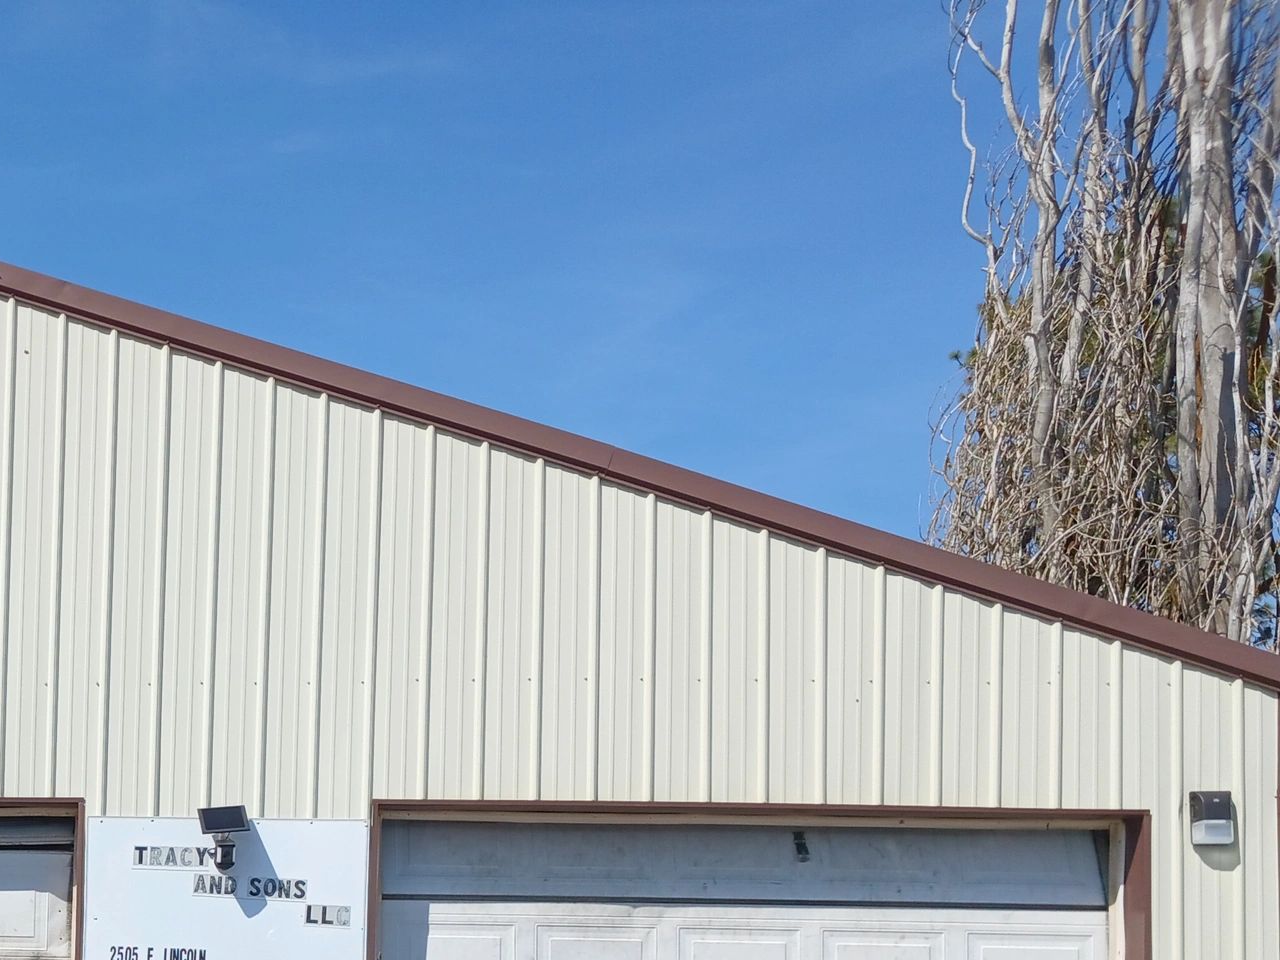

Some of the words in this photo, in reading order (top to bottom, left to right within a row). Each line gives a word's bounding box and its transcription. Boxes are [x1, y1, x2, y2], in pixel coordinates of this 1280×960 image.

[193, 874, 237, 895] AND
[249, 877, 306, 899] SONS
[306, 905, 350, 926] LLC
